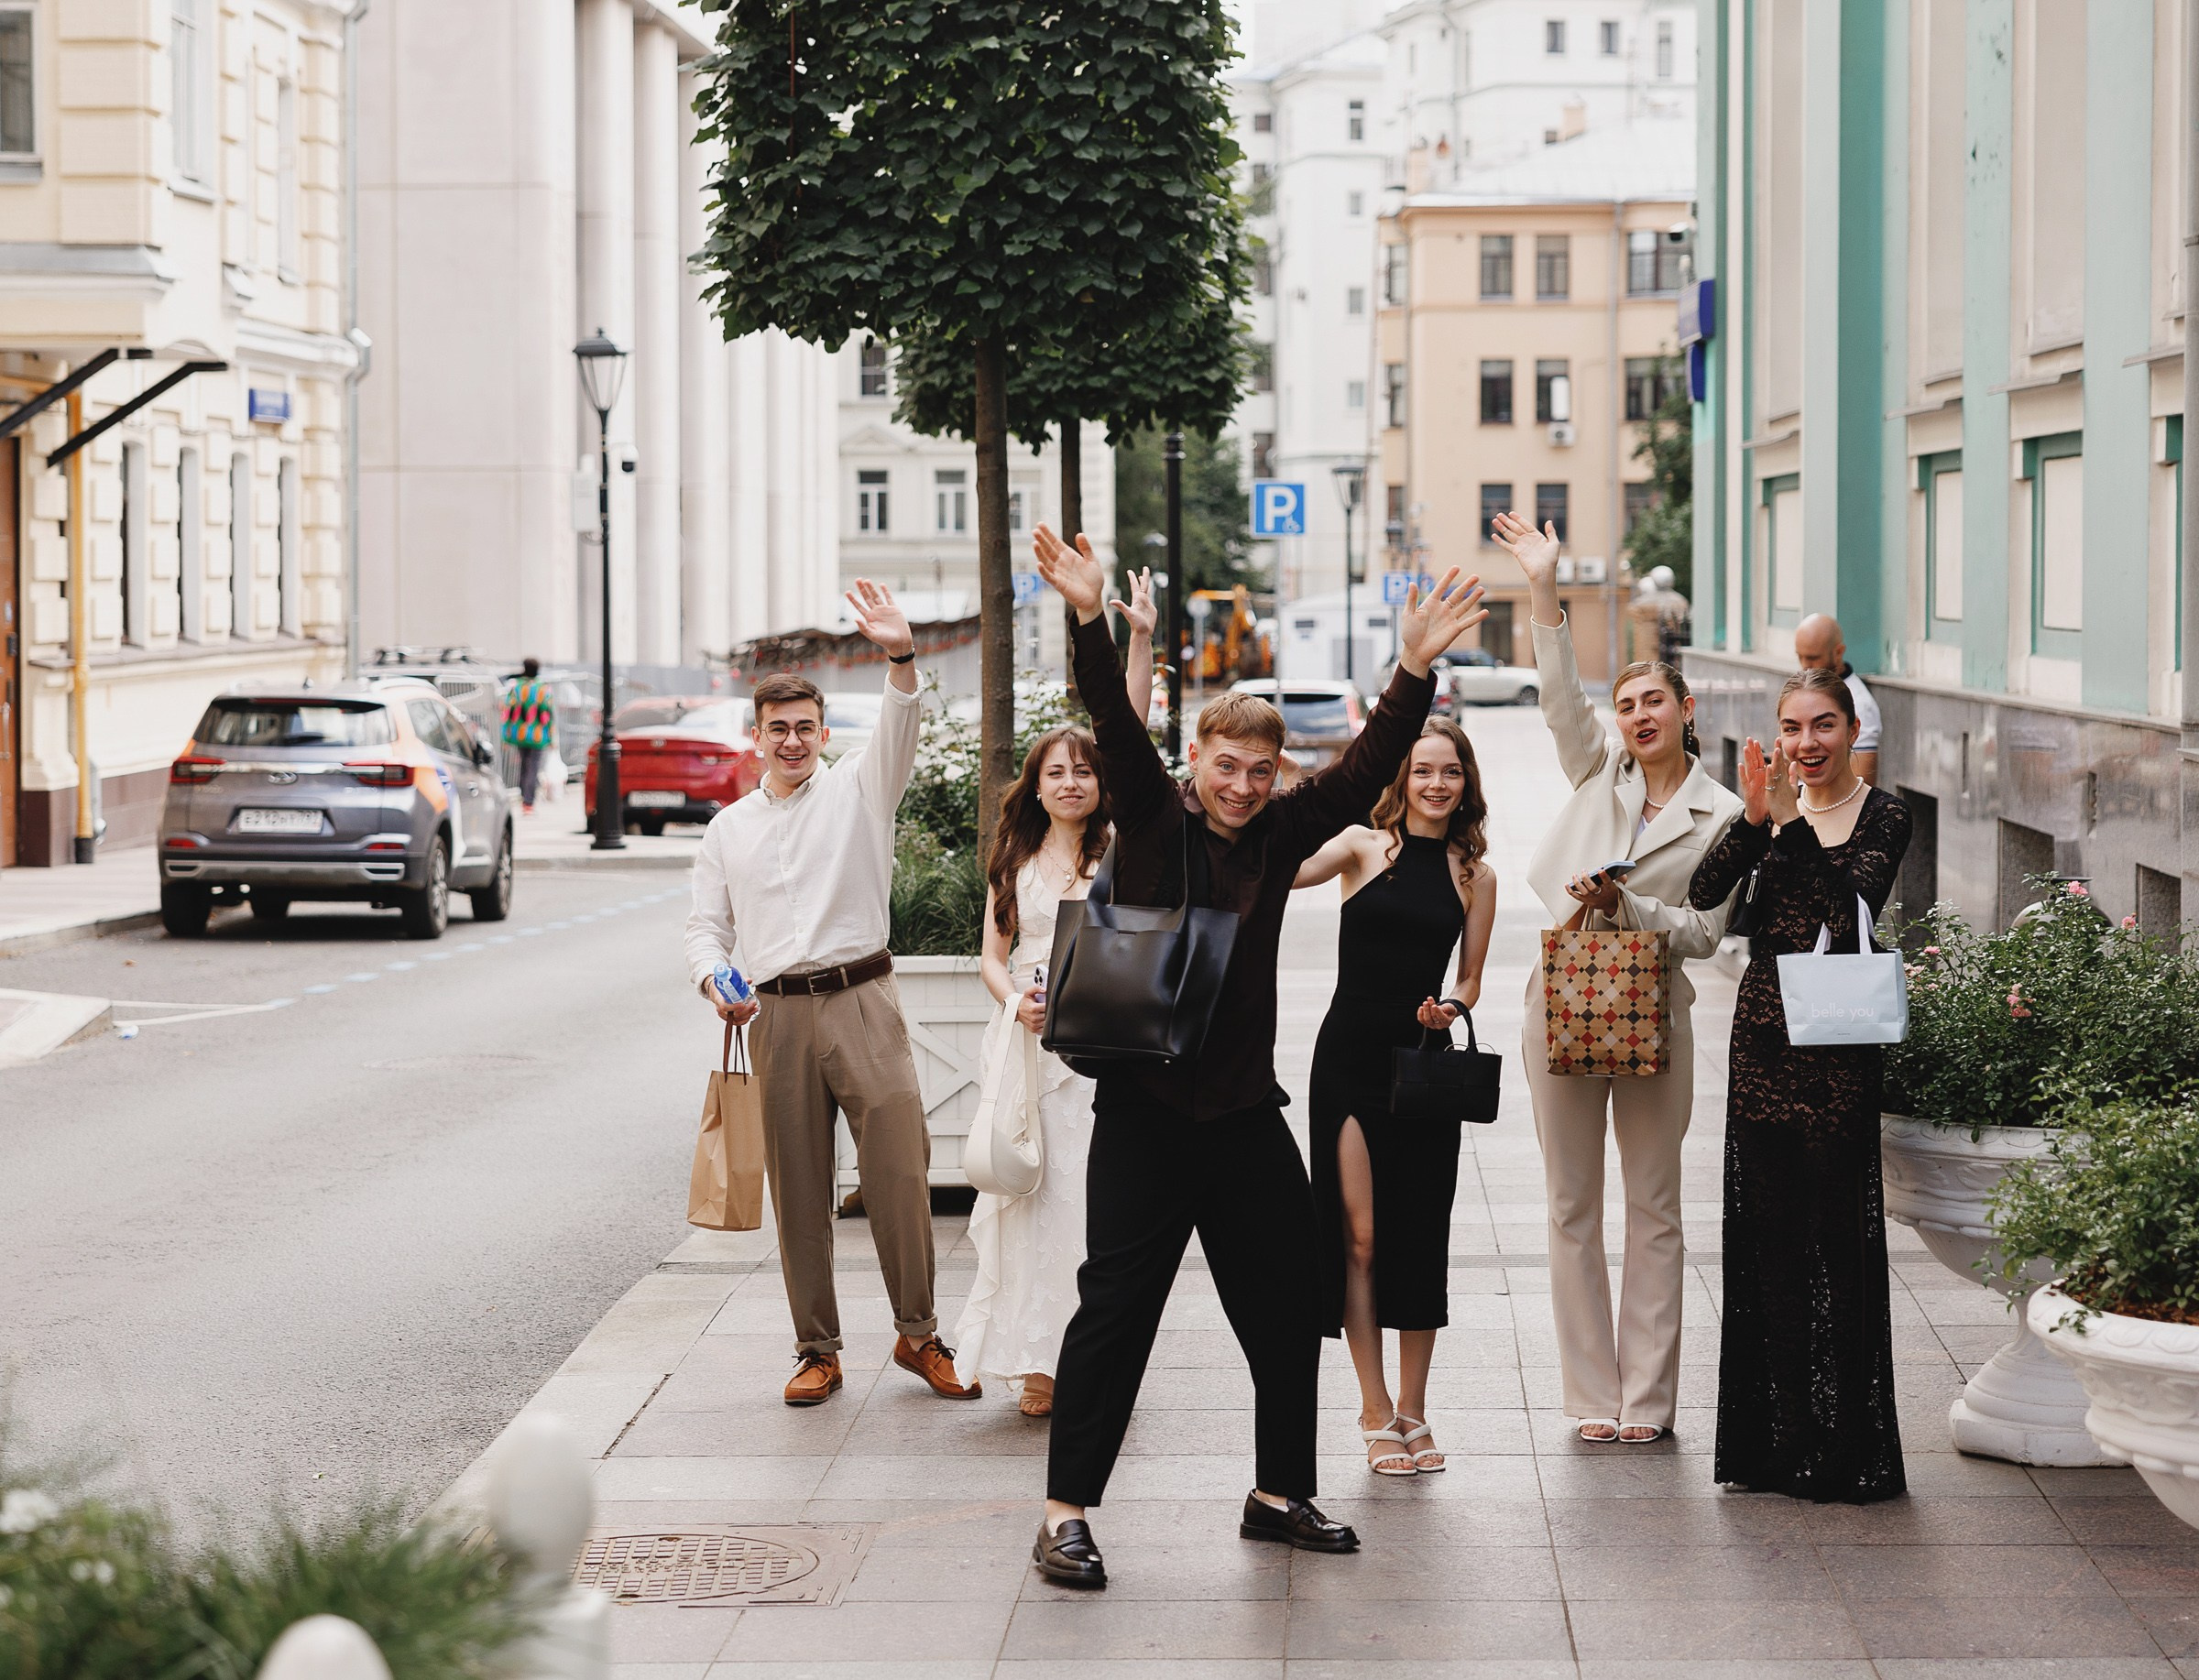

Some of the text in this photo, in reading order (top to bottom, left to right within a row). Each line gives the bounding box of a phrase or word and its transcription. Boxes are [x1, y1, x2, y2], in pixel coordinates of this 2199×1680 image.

[1264, 485, 1297, 532] P
[1811, 1002, 1875, 1022] belle you
